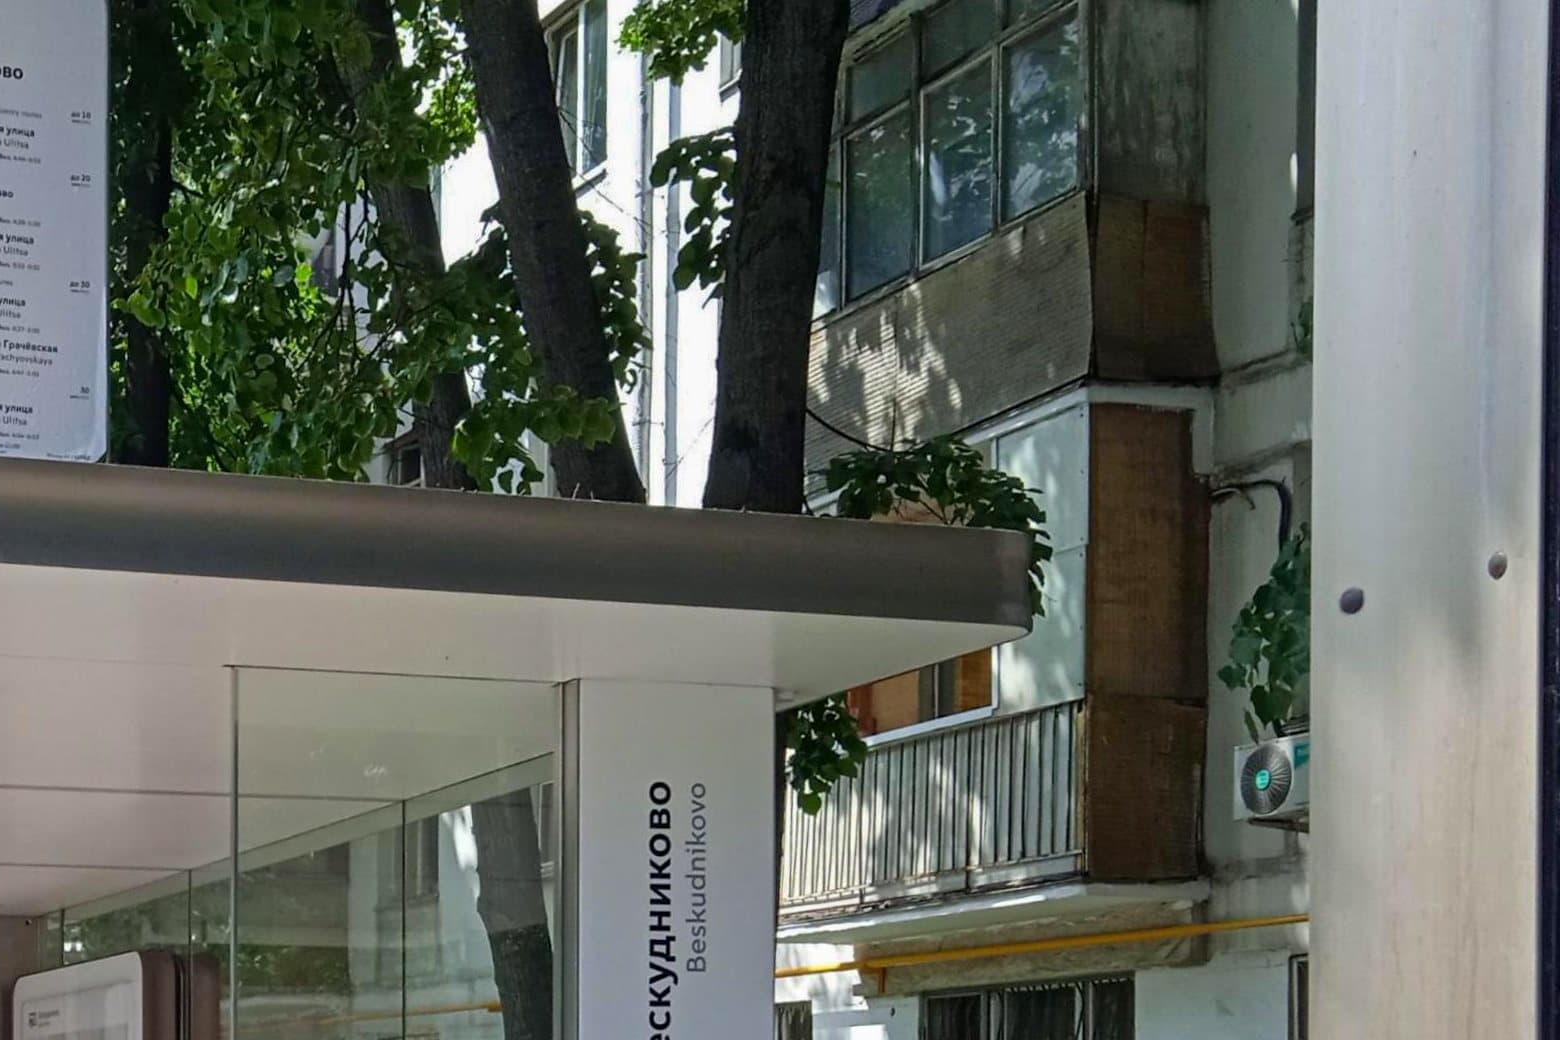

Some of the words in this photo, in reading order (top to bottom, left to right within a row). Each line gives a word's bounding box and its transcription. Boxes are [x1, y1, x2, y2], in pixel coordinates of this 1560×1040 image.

[6, 127, 35, 137] улица
[5, 234, 34, 245] улица
[5, 404, 34, 414] улица
[685, 782, 706, 973] Beskudnikovo
